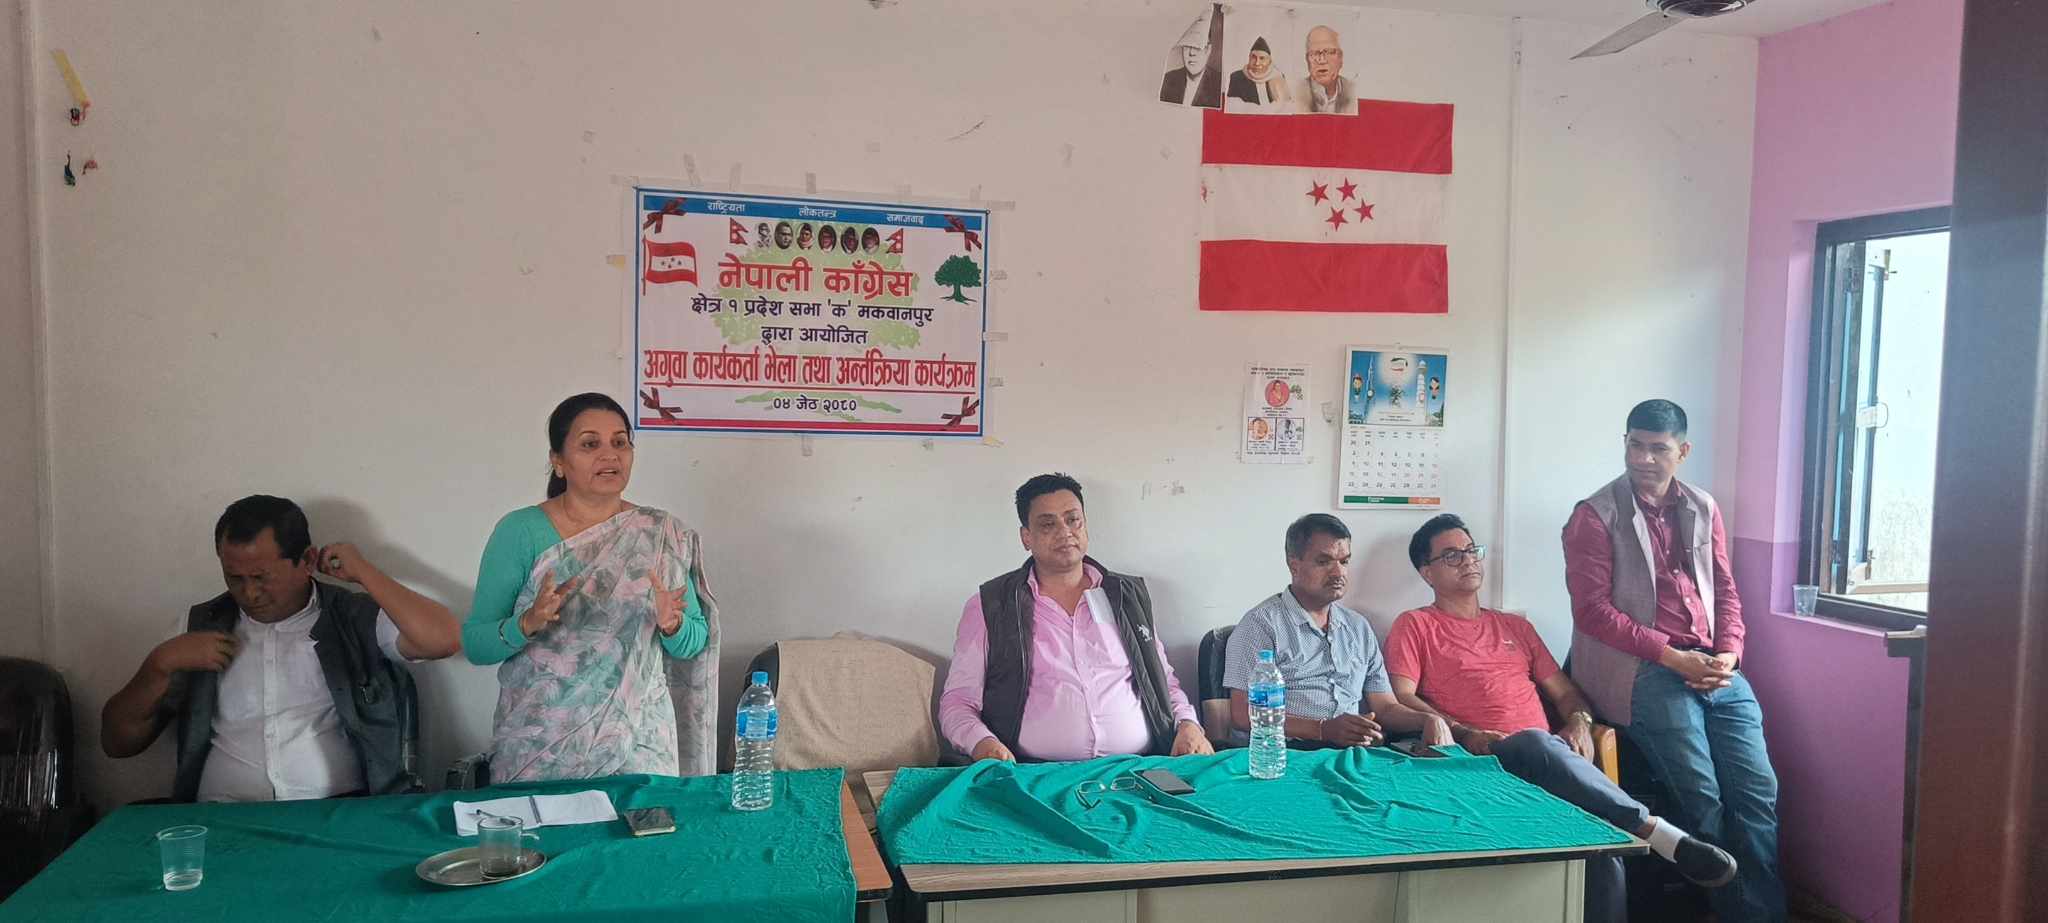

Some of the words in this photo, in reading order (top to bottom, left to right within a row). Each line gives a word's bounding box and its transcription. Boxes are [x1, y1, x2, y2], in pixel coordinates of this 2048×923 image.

[718, 253, 813, 291] नेपाली
[824, 259, 914, 300] काँग्रेस
[691, 296, 722, 313] क्षेत्र
[729, 301, 738, 313] १
[743, 296, 781, 316] प्रदेश
[790, 301, 821, 316] सभा
[858, 306, 933, 327] मकवानपुर
[761, 327, 792, 345] द्वारा
[800, 326, 867, 345] आयोजित
[644, 349, 687, 386] अगुवा
[693, 344, 760, 382] कार्यकर्ता
[764, 345, 798, 383] भेला
[803, 355, 831, 384] तथा
[915, 353, 976, 388] कार्यक्रम
[773, 398, 790, 409] ०४
[796, 396, 818, 409] जेठ
[823, 399, 857, 412] २०८०
